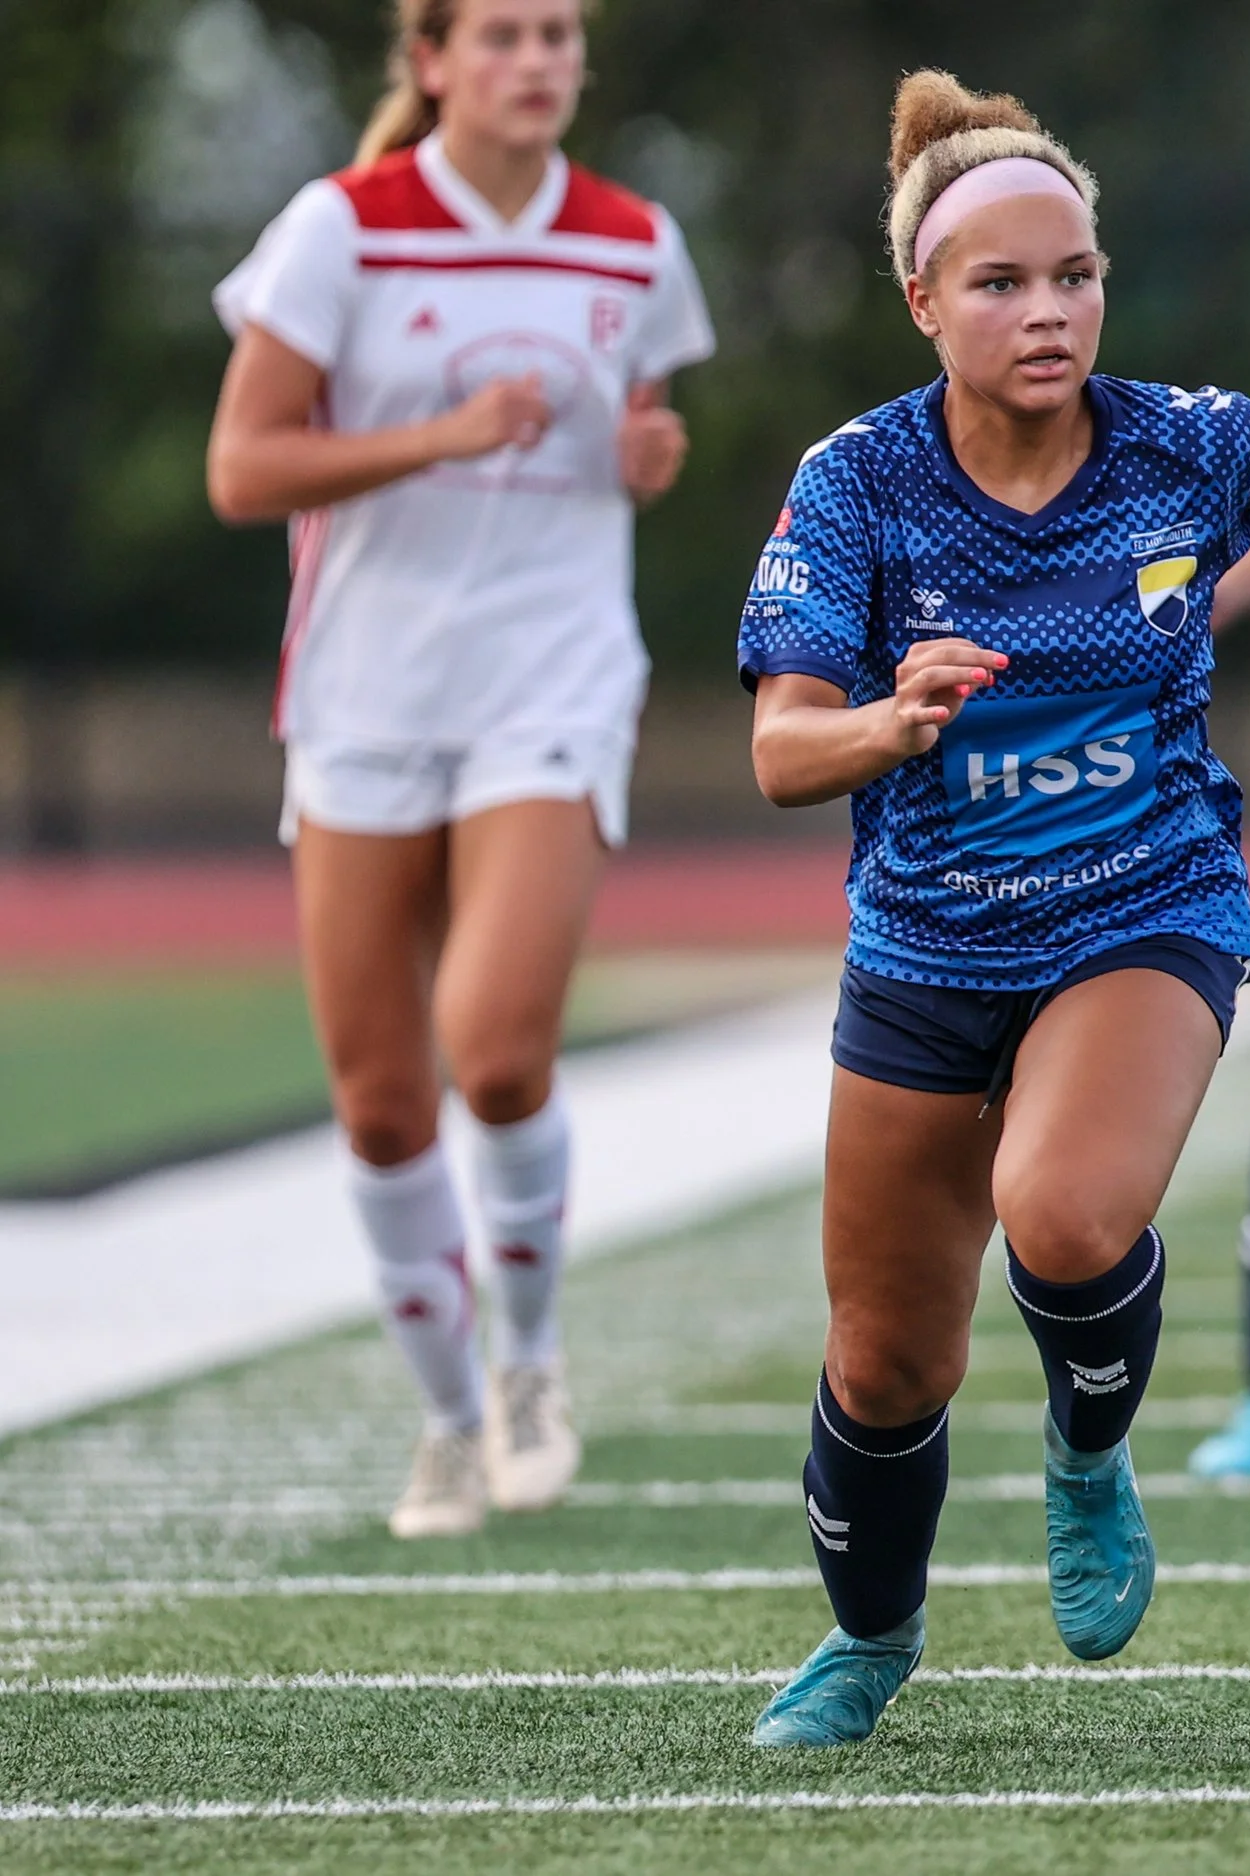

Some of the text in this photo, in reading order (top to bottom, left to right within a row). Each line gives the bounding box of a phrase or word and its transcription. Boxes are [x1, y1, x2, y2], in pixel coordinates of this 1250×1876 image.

[1133, 540, 1144, 551] FC
[749, 555, 810, 594] ONG
[905, 615, 954, 632] hummel
[967, 733, 1136, 802] HSS
